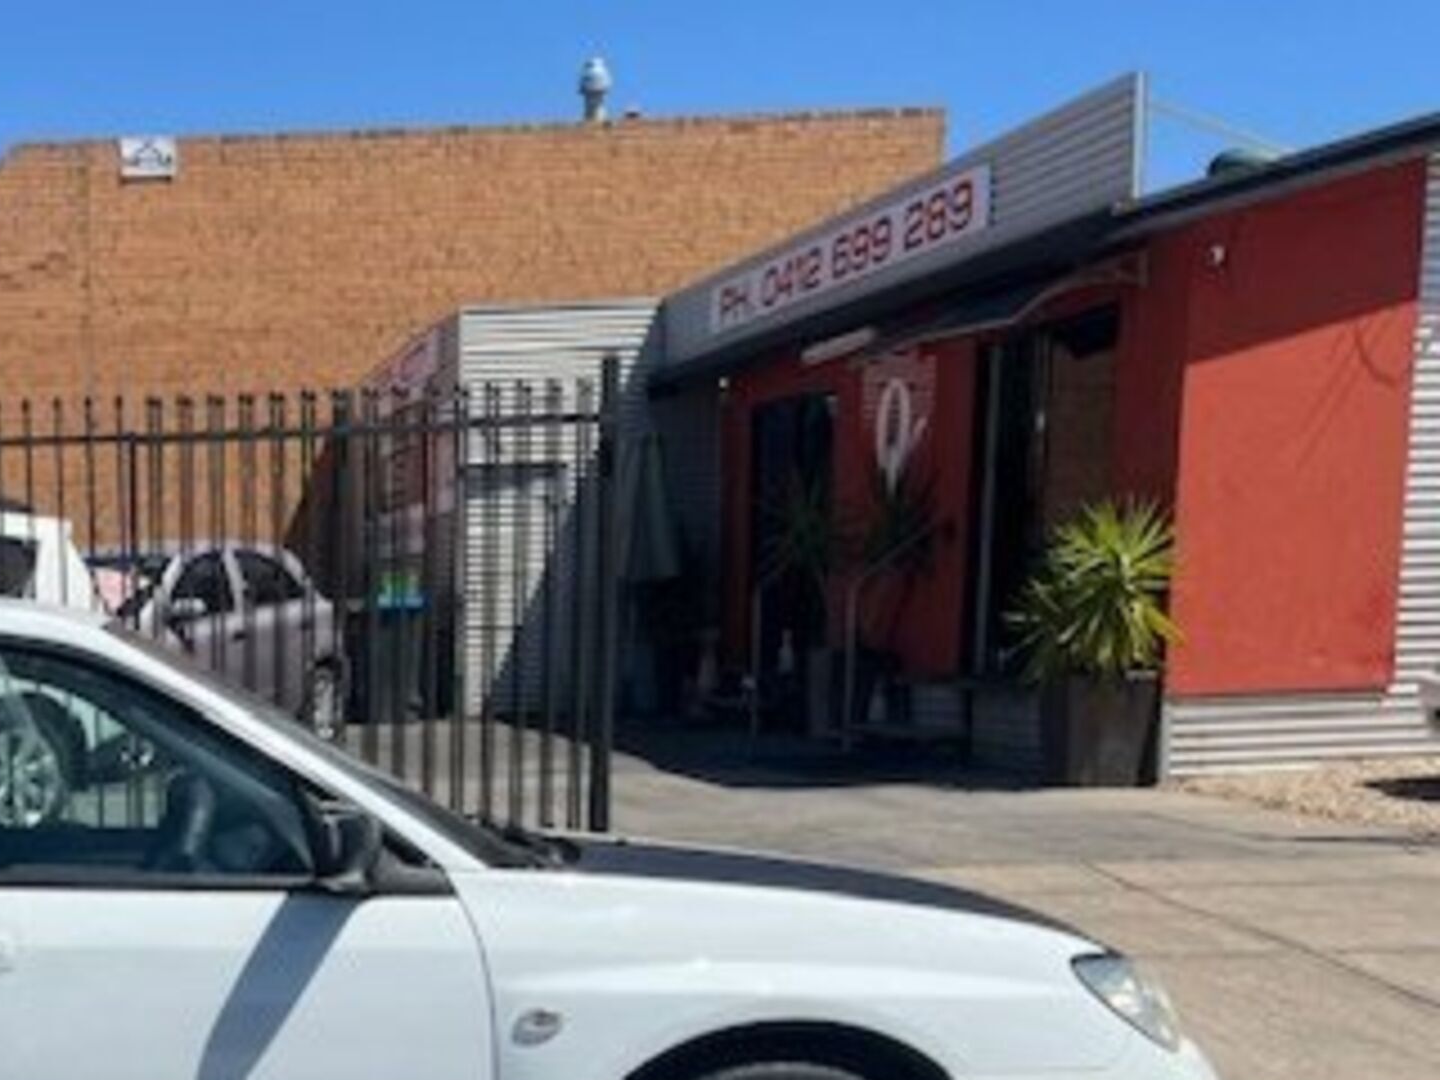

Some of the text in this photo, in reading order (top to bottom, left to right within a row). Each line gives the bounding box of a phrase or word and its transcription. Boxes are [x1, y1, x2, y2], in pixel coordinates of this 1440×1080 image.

[762, 248, 821, 307] 0412
[831, 216, 891, 279] 699
[903, 180, 973, 250] 289
